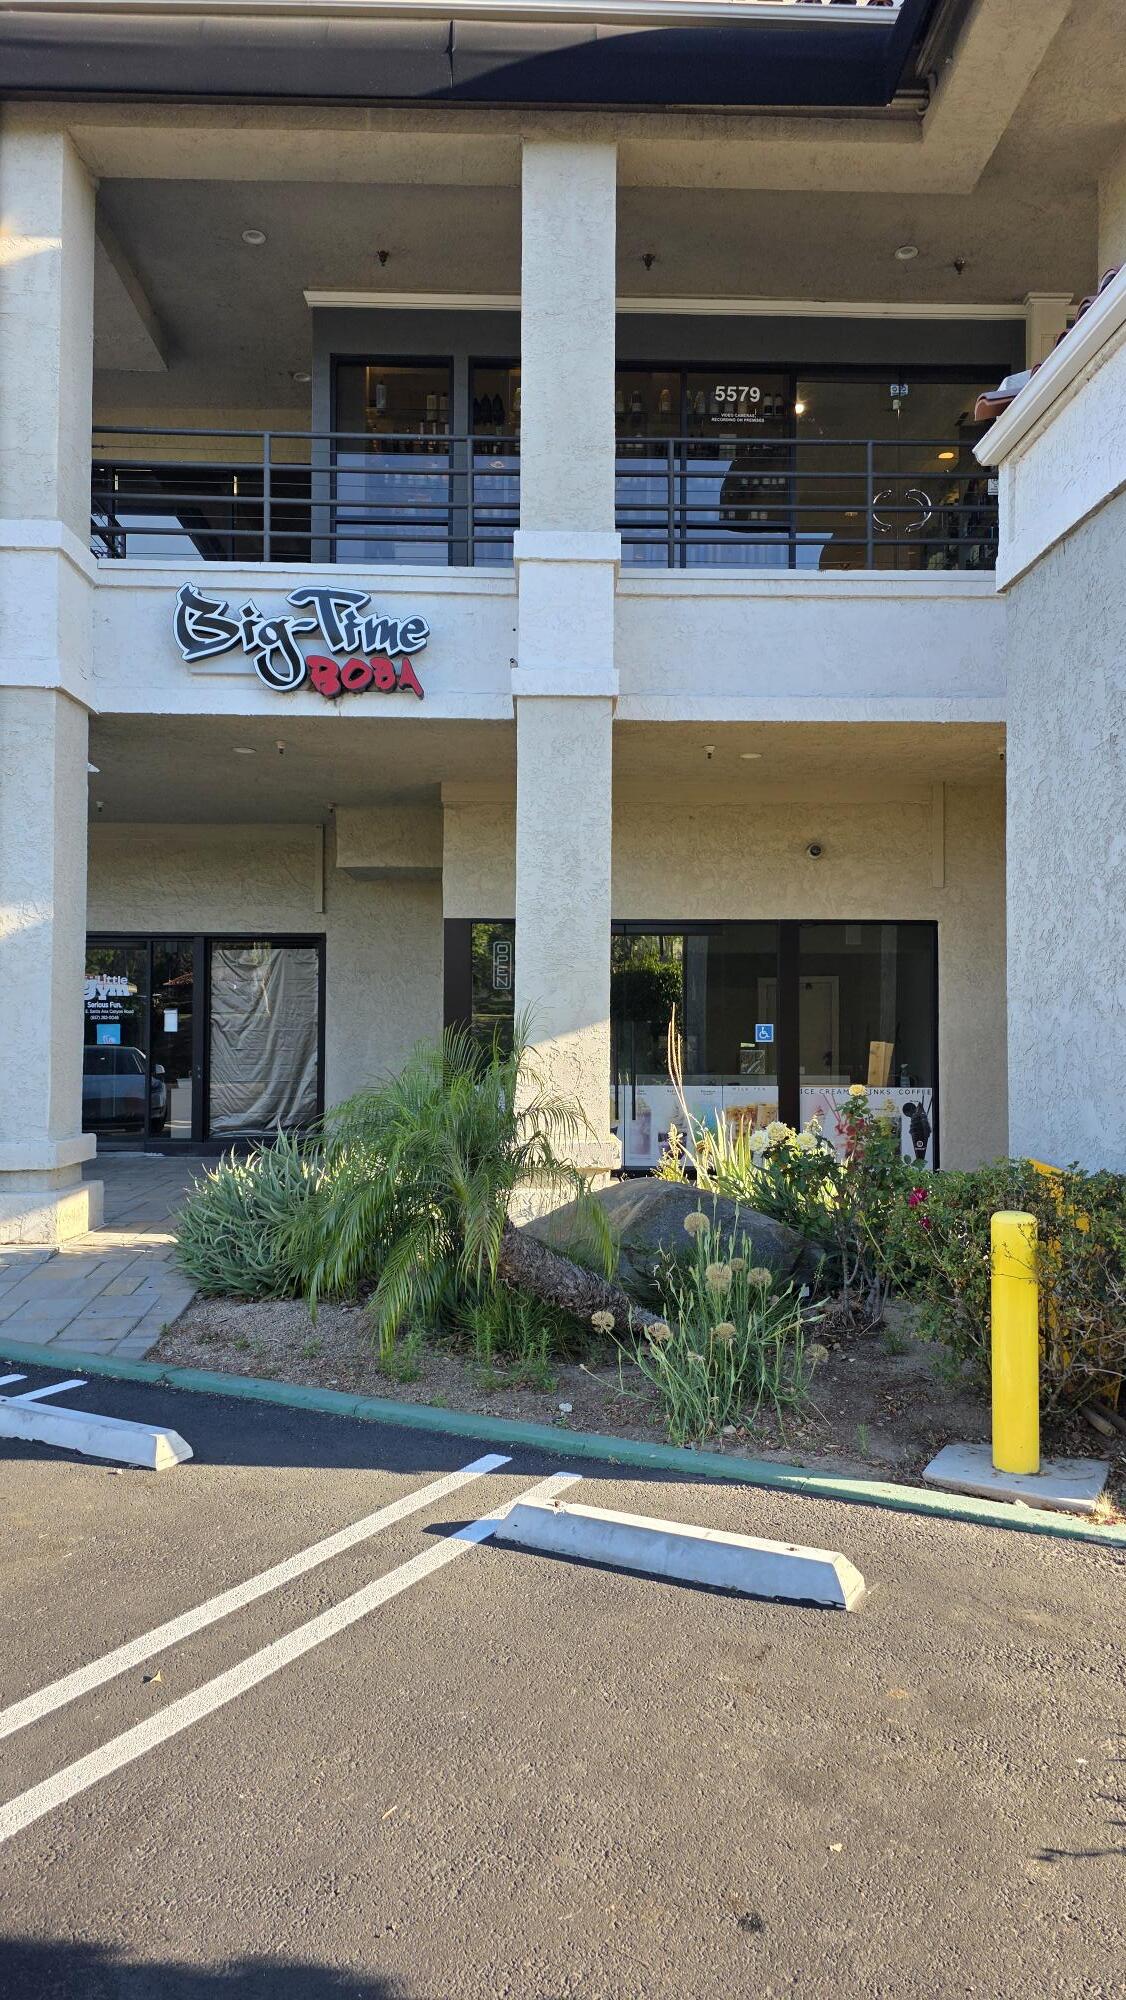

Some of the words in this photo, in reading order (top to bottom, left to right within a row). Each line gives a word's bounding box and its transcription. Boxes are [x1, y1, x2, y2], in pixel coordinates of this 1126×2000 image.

[715, 386, 760, 402] 5579
[305, 655, 425, 700] BOBA
[97, 974, 128, 985] Little
[496, 944, 508, 987] OPEN
